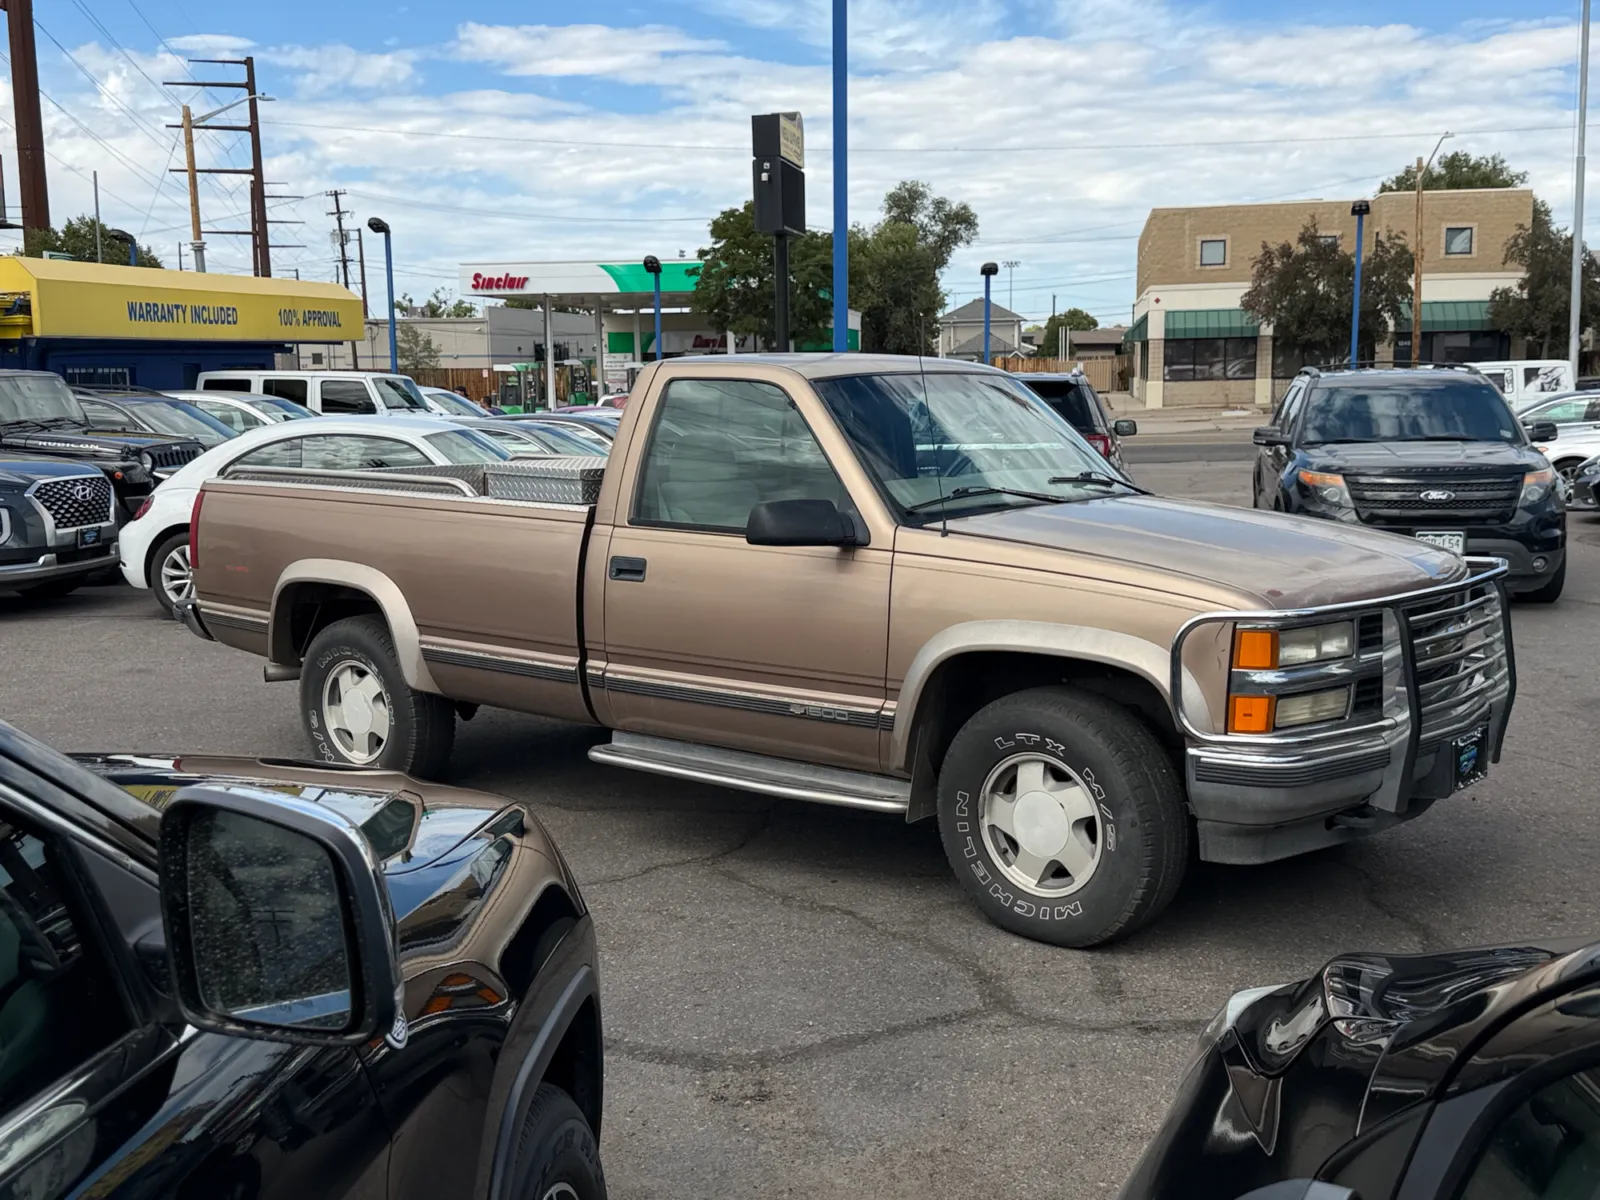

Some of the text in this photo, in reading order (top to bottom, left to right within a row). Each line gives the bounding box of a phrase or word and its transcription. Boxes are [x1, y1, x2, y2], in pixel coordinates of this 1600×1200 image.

[472, 273, 529, 289] Sinclair
[127, 301, 238, 325] WARRANTY INCLUDED
[278, 308, 342, 327] 100% APPROVAL
[38, 440, 99, 449] RUBICON
[1428, 491, 1448, 500] Ford
[994, 733, 1066, 756] LTX
[956, 791, 1083, 920] MICHELIN
